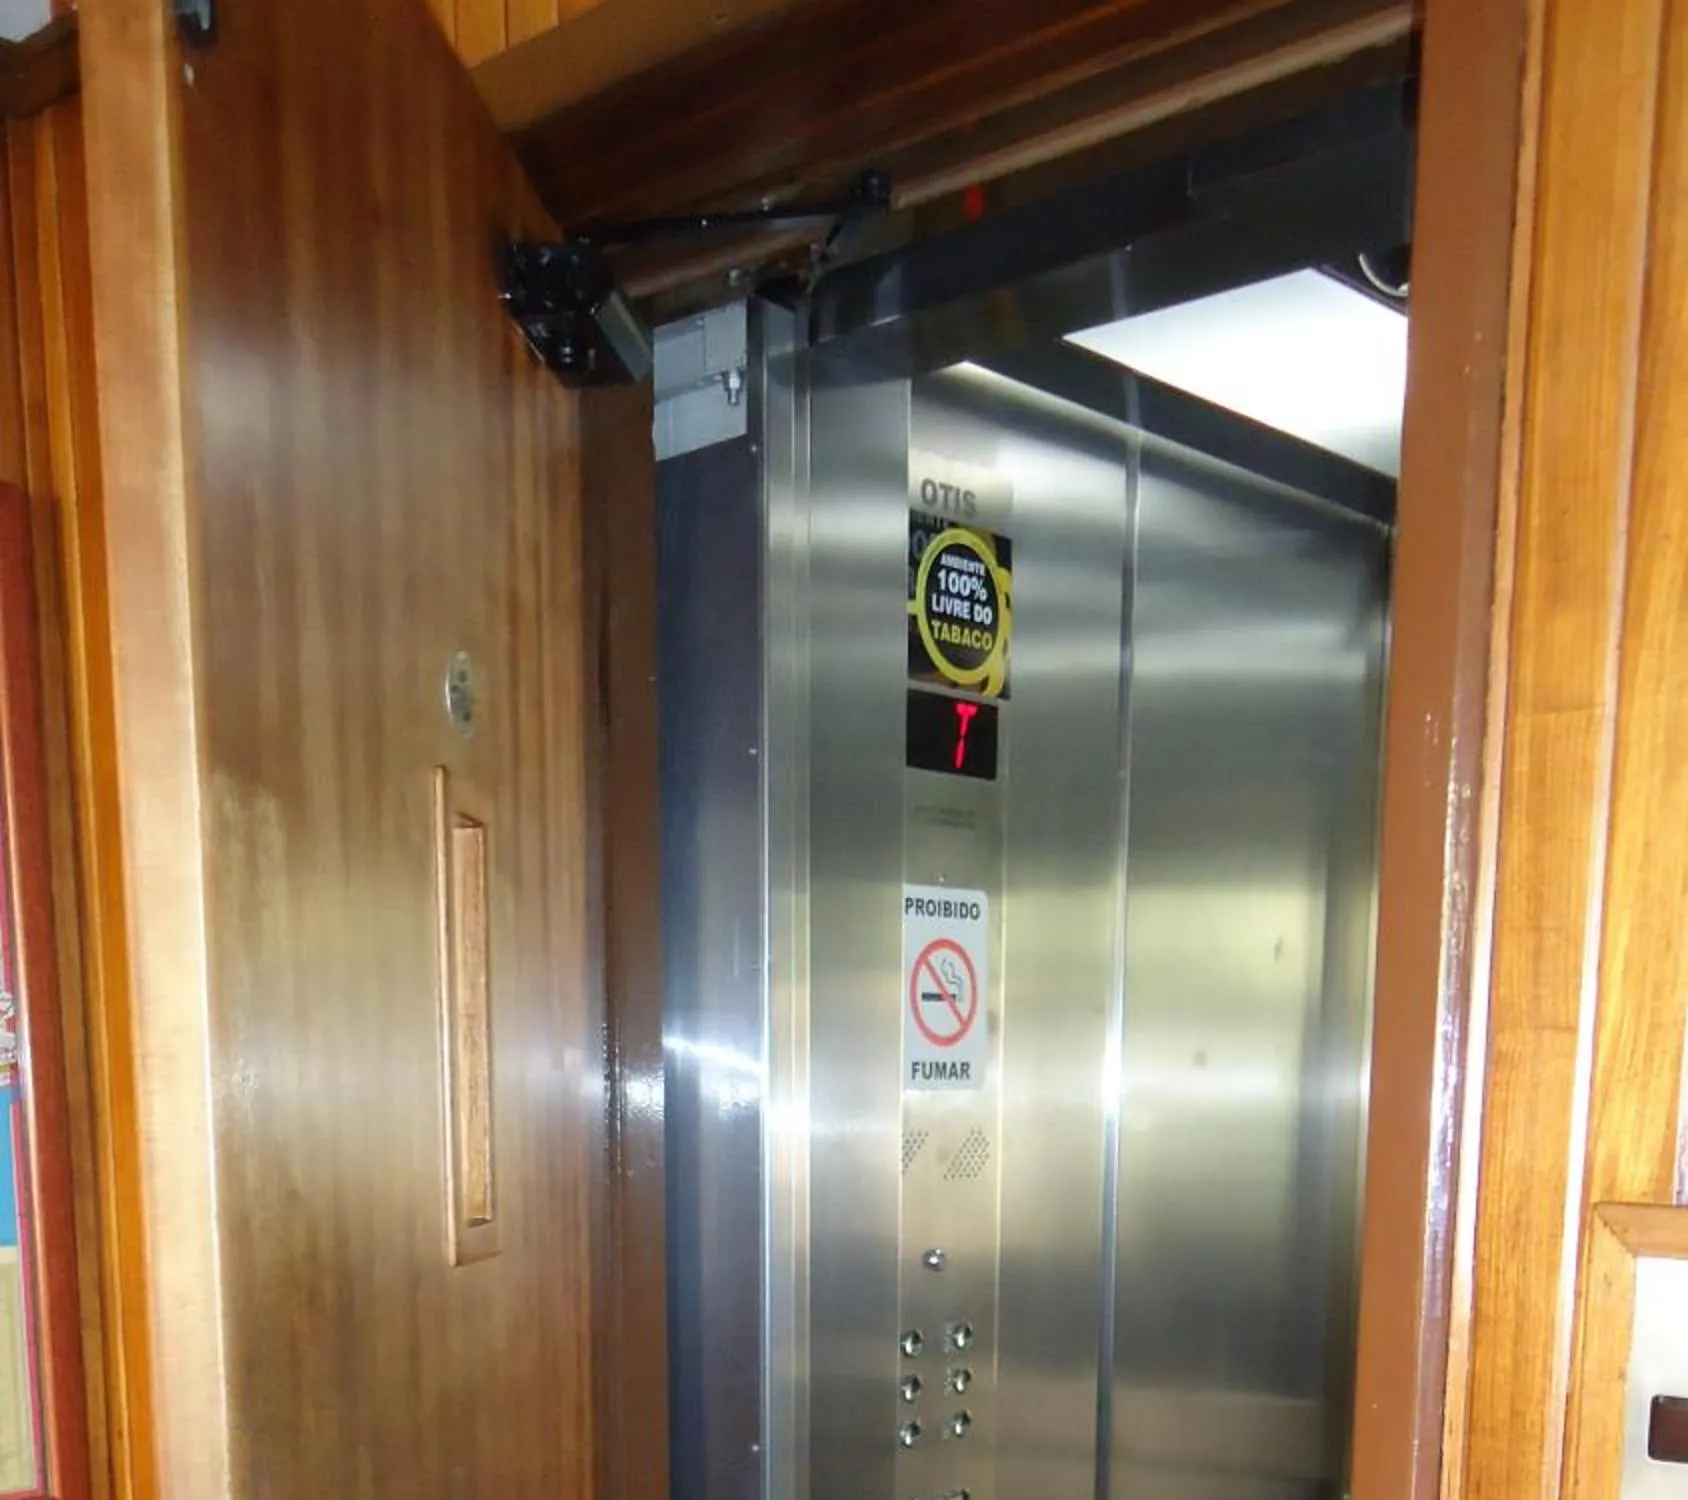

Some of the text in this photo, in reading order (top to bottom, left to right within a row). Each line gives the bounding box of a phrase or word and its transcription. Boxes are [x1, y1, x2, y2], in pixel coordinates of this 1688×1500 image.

[921, 478, 977, 517] OTIS
[940, 554, 985, 576] AMBIENTE
[938, 570, 987, 600] 100%
[931, 593, 993, 625] LIVRE DO
[931, 620, 993, 650] TABACO
[904, 897, 981, 920] PROIBIDO
[911, 1061, 971, 1081] FUMAR
